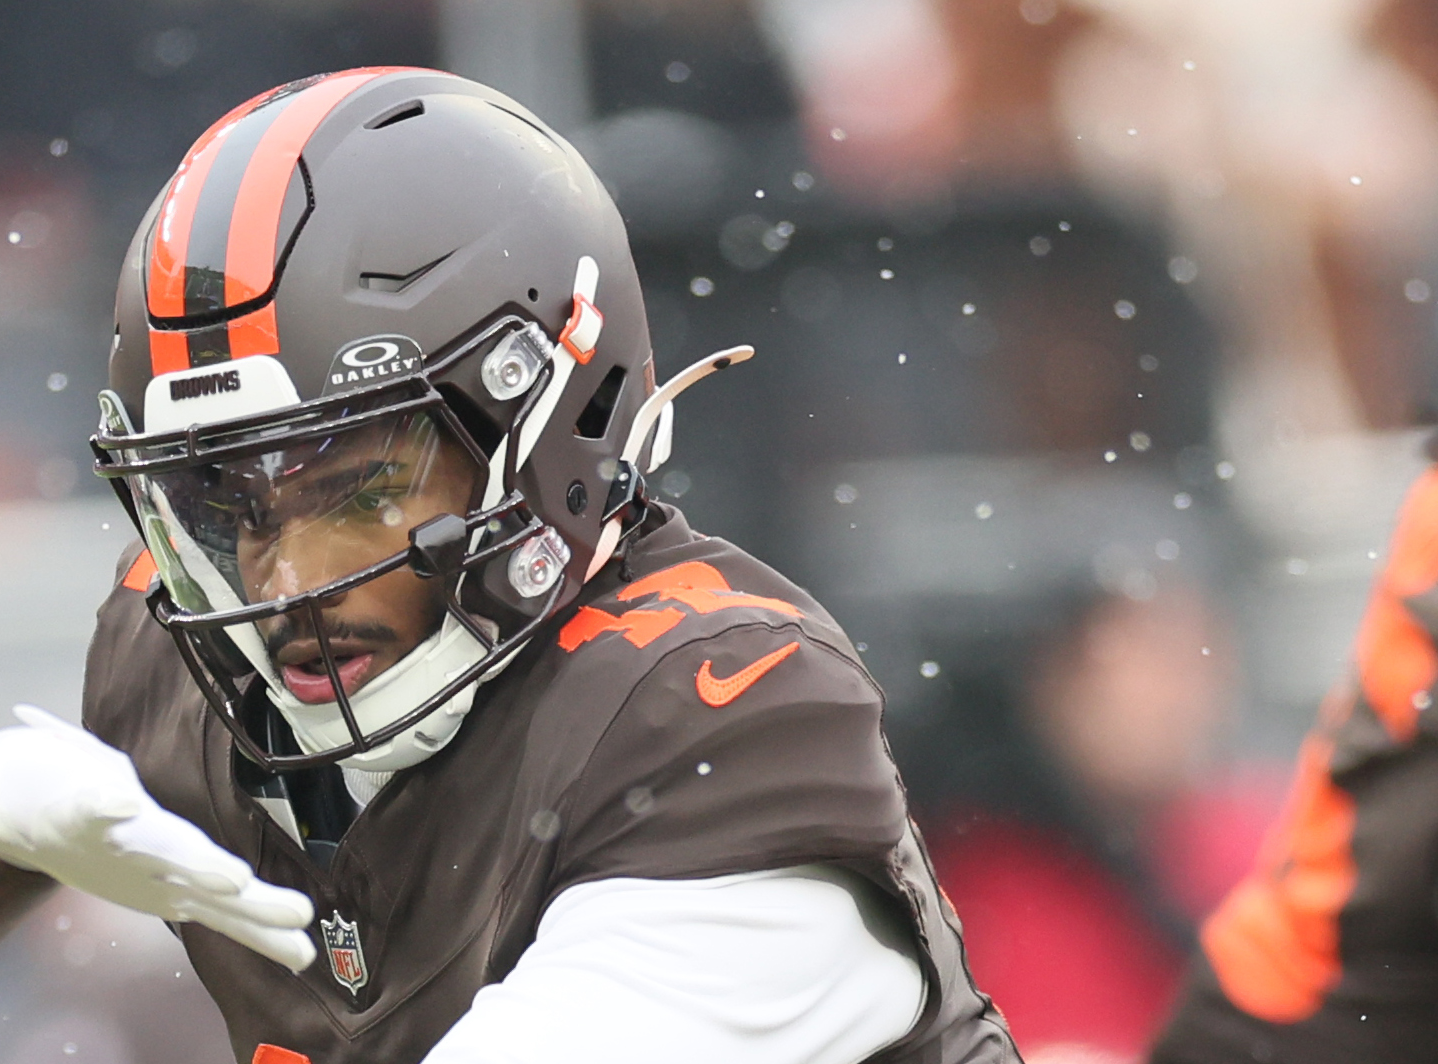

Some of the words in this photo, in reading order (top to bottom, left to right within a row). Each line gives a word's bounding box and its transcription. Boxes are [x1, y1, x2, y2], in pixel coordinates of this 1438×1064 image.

[169, 370, 241, 401] BROWNS
[331, 358, 414, 385] OAKLEY
[333, 949, 362, 980] NFL
